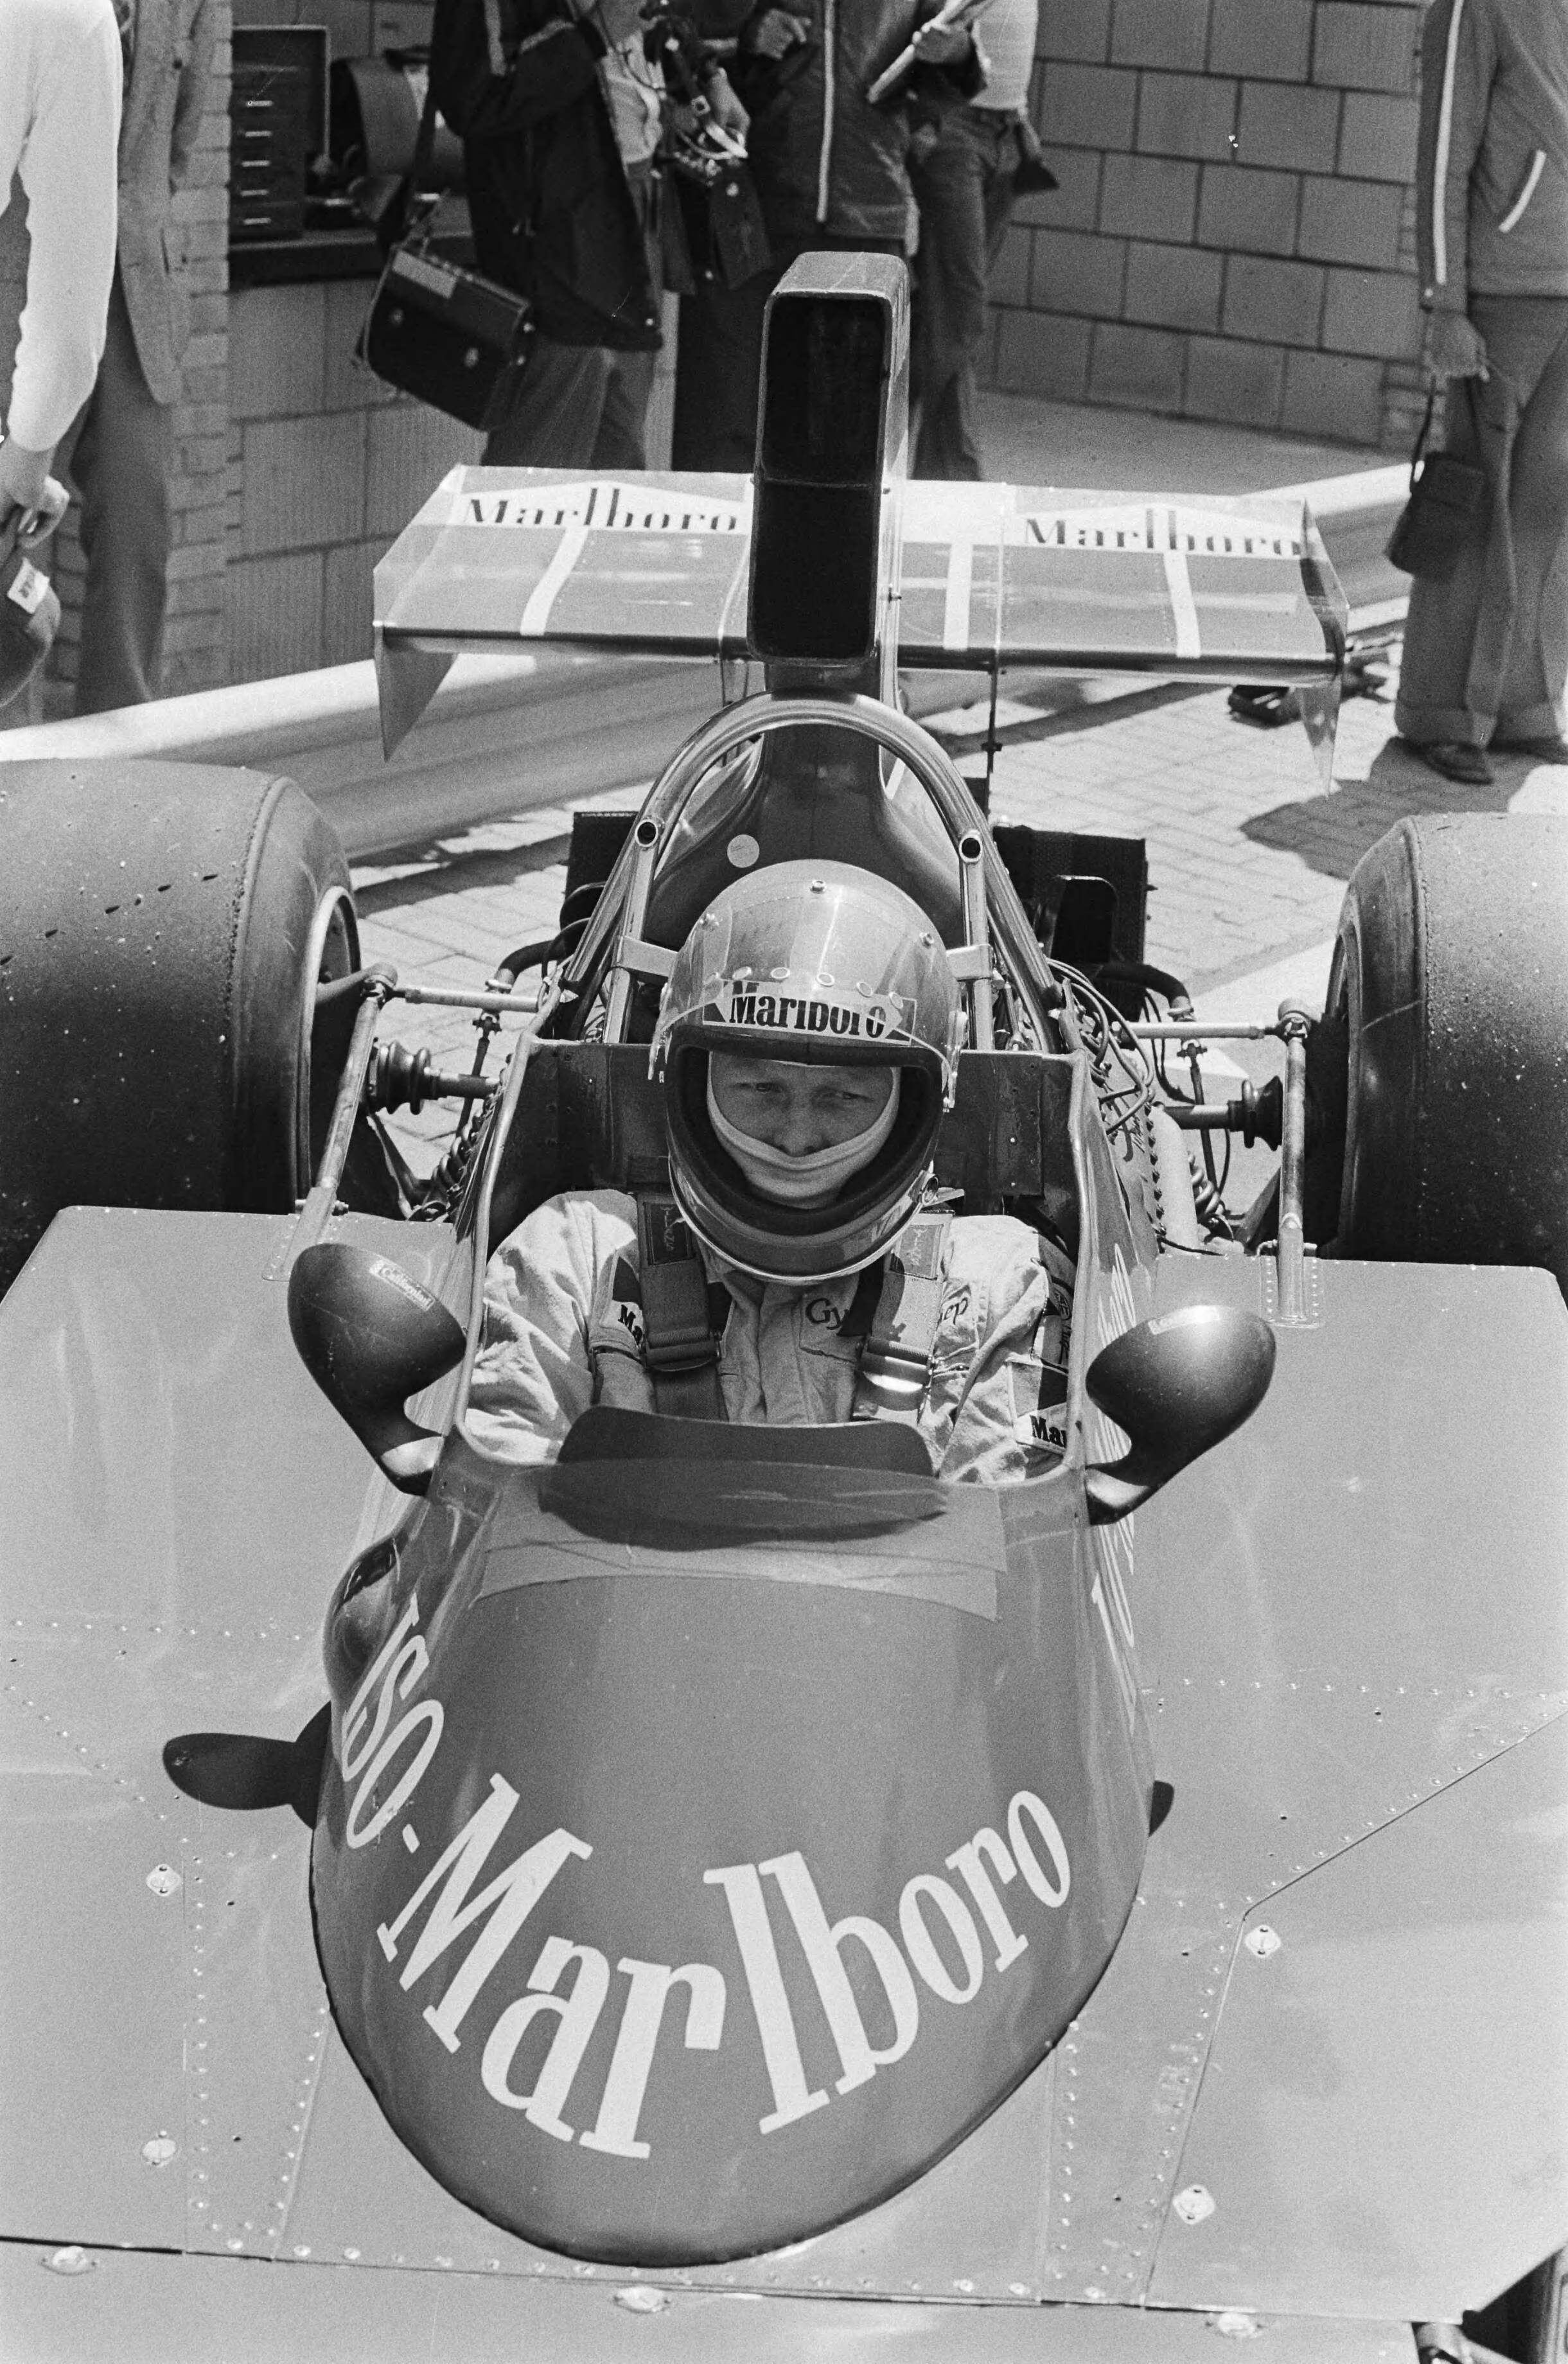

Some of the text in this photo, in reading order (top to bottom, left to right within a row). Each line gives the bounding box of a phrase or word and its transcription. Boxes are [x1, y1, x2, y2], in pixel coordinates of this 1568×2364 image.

[465, 487, 737, 531] Marlboro
[1026, 508, 1301, 556] Marlboro
[728, 981, 887, 1038] Marlboro
